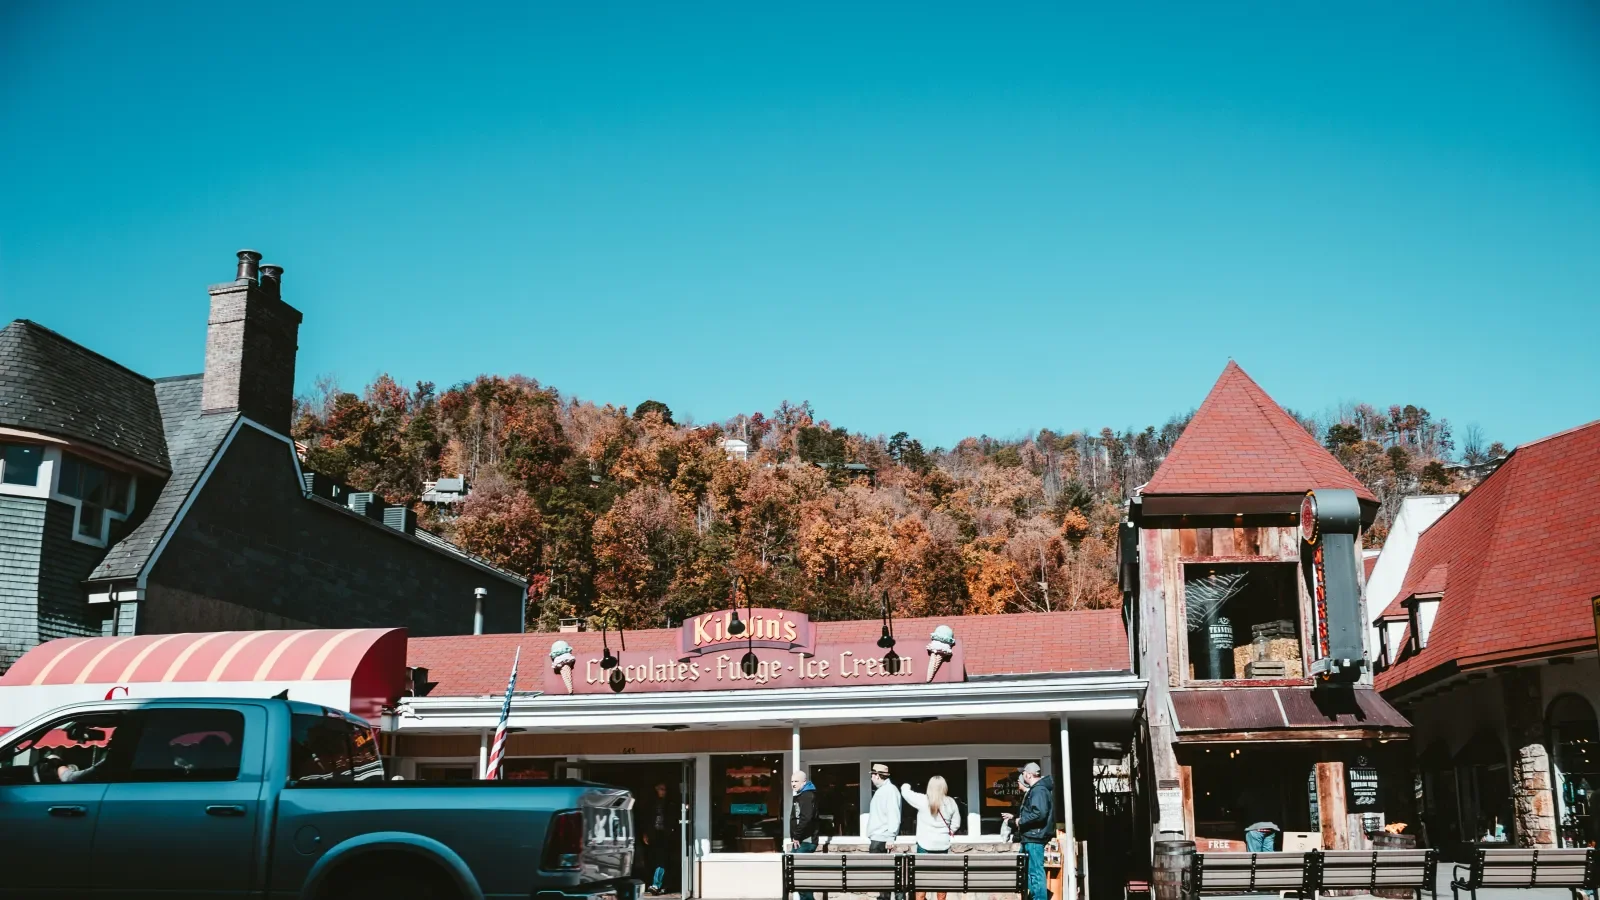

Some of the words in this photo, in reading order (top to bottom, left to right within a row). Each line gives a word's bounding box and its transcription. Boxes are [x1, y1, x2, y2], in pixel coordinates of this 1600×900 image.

[716, 653, 782, 685] Fudge
[798, 652, 830, 680] Ice
[840, 650, 913, 679] Cream
[1208, 840, 1230, 849] FREE
